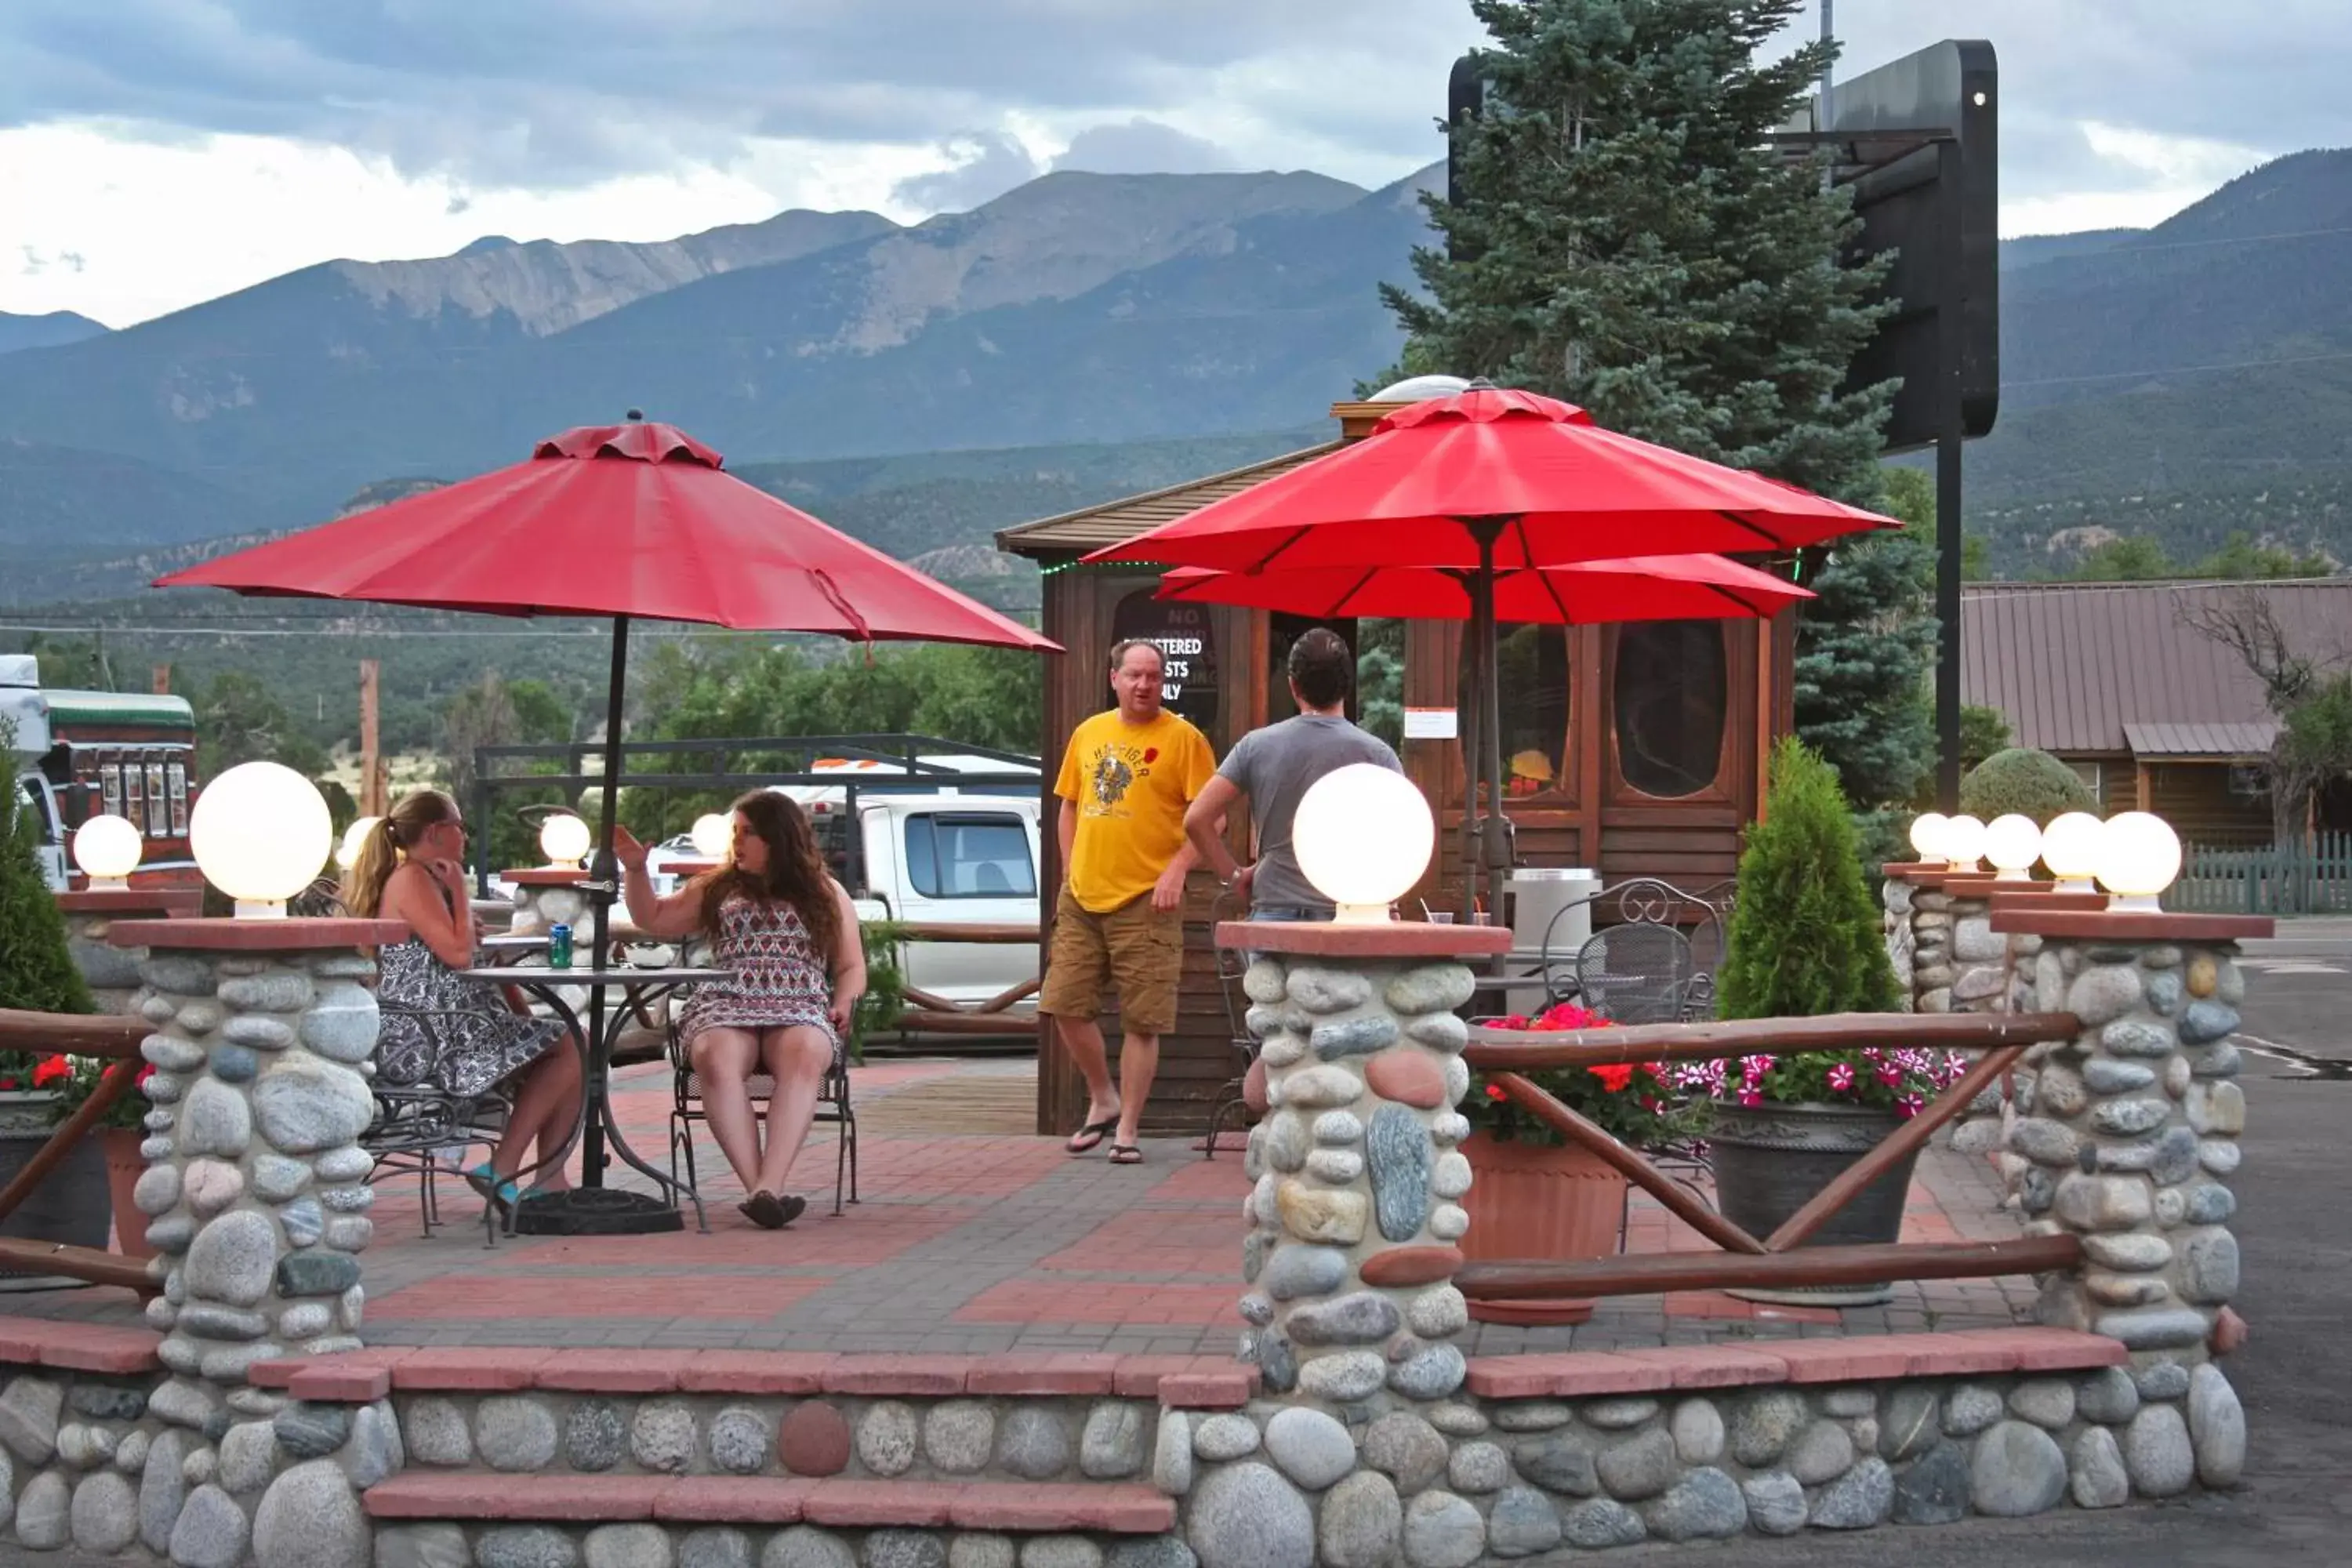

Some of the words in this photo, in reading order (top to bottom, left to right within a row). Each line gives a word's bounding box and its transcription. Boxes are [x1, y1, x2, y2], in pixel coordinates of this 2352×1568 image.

[1123, 638, 1202, 655] STERED
[1164, 661, 1189, 677] STS
[1162, 684, 1181, 700] NLY
